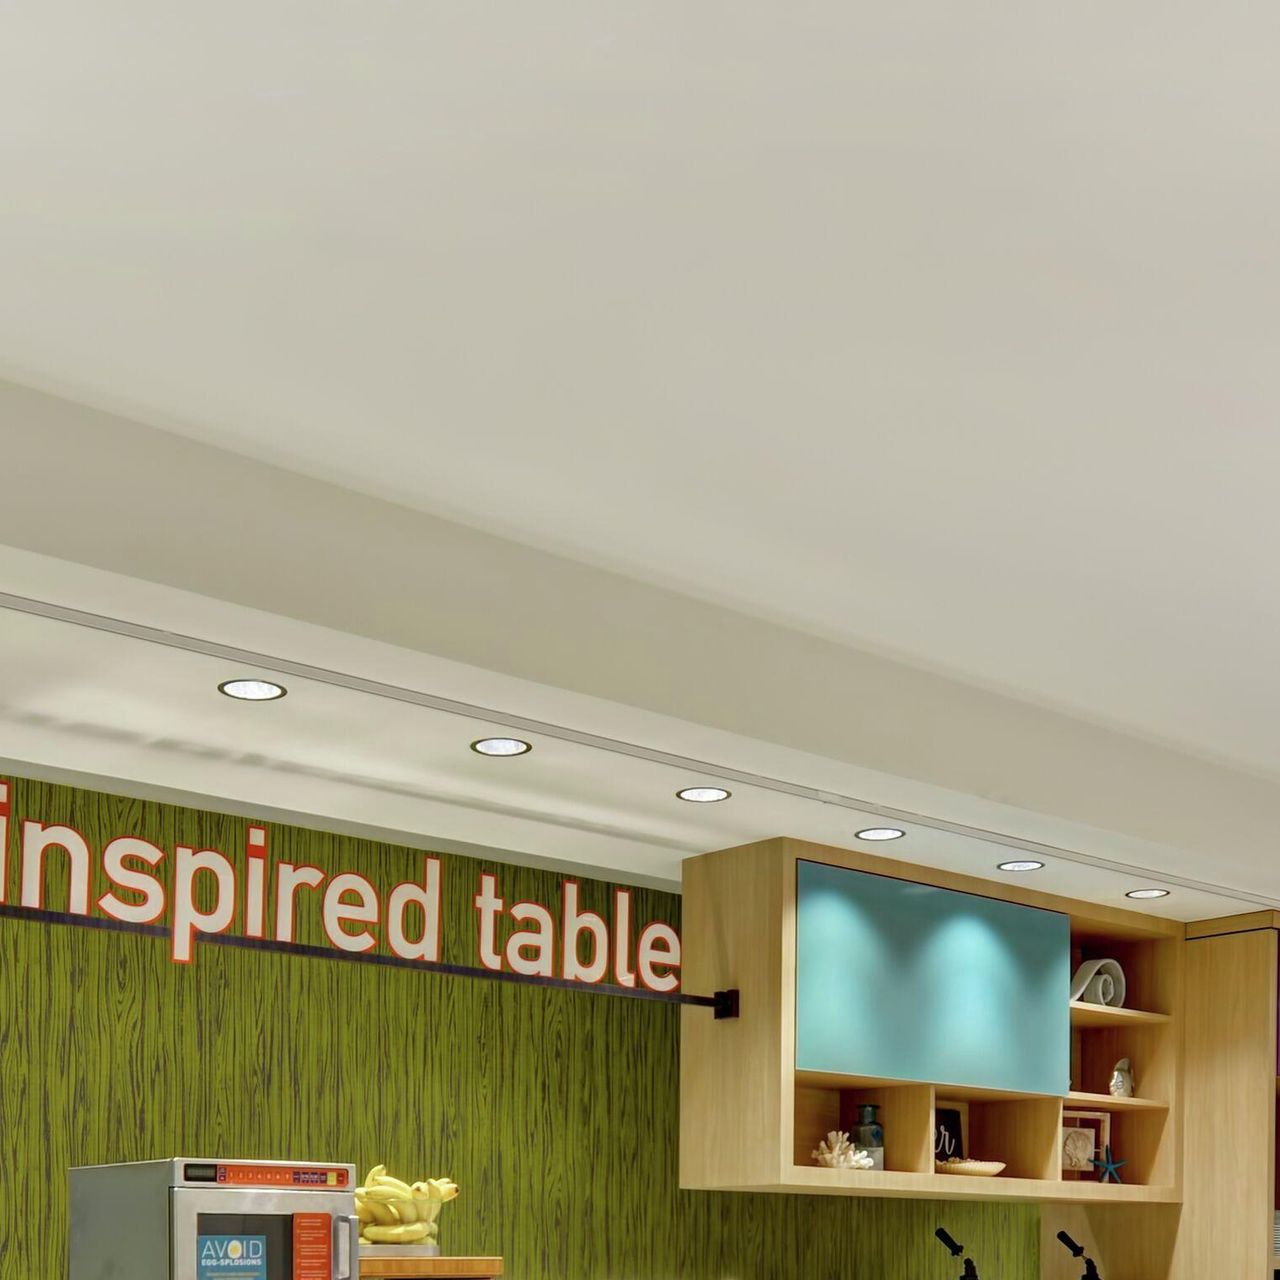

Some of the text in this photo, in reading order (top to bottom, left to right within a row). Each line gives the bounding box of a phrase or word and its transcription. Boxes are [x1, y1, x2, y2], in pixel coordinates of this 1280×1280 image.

[475, 874, 682, 993] table
[202, 1240, 262, 1259] AVOID
[201, 1259, 262, 1267] EGG-SPLOSIONS
